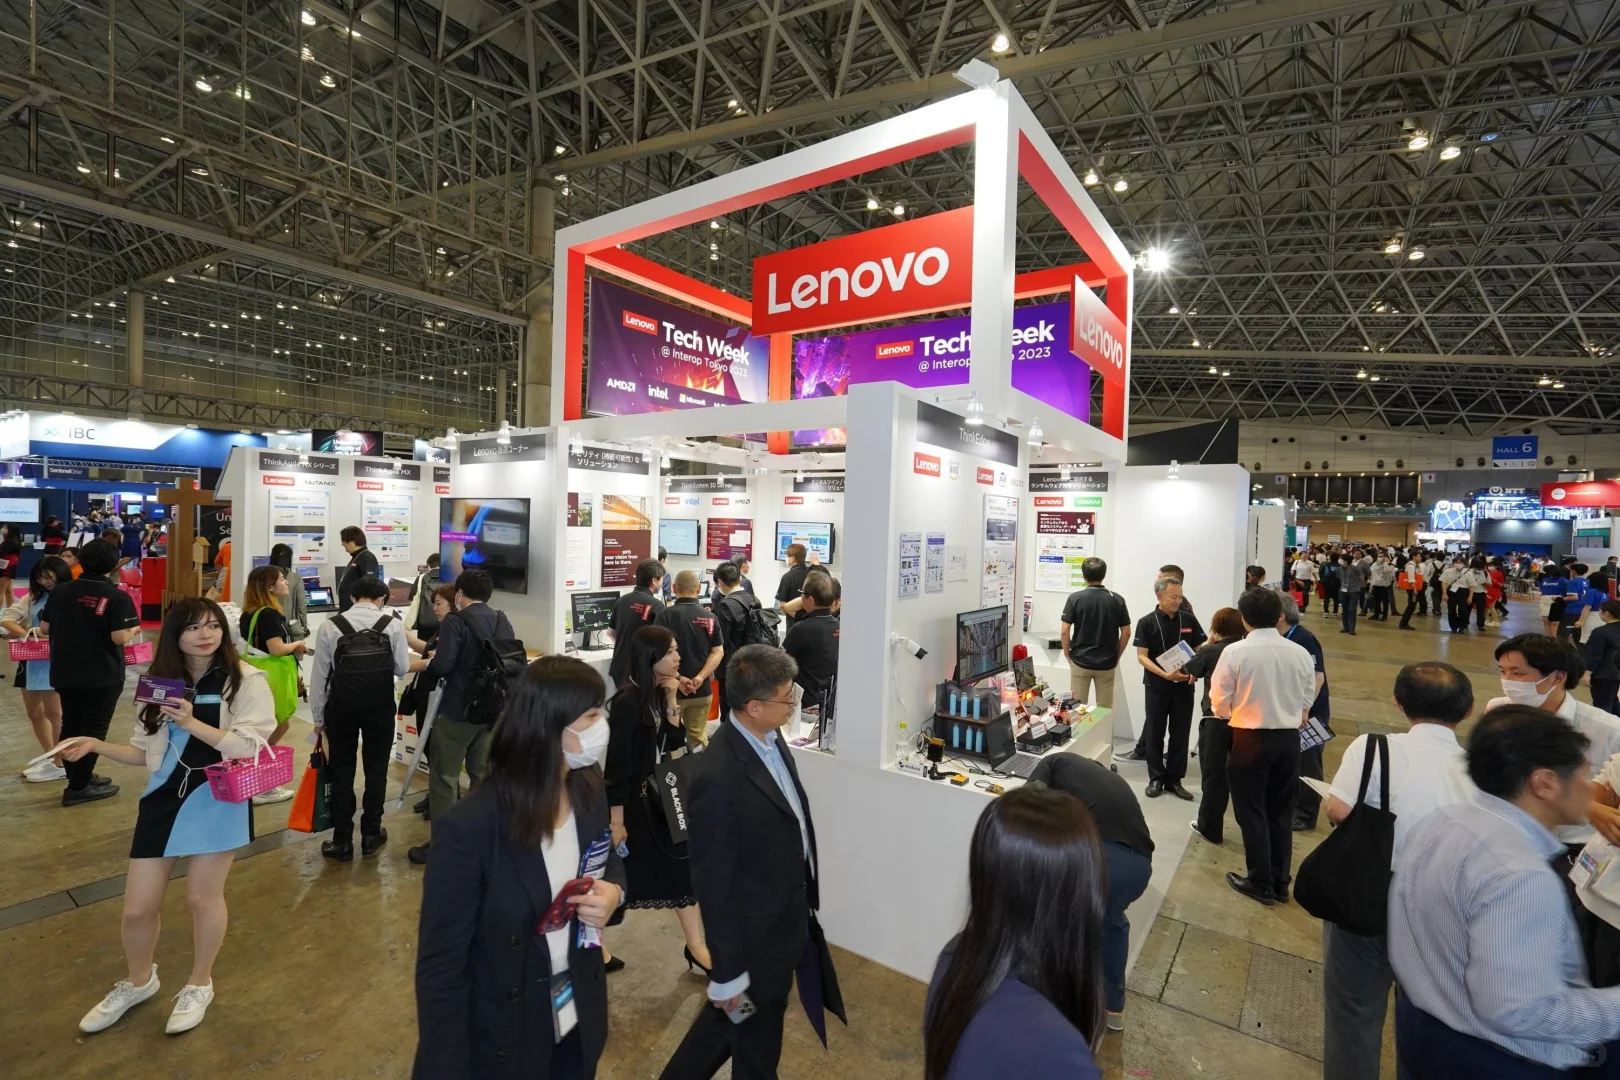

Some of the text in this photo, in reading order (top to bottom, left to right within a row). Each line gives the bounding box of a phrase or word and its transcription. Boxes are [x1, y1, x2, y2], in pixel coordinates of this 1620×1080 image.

[768, 247, 949, 315] Lenovo
[625, 314, 655, 331] Lenovo
[1012, 320, 1055, 347] eek
[1079, 299, 1123, 369] Lenovo
[662, 321, 750, 366] Tech Week
[878, 343, 911, 355] Lenovo
[661, 346, 748, 378] @ Interop Tokyo 2023
[918, 360, 929, 373] @
[933, 357, 971, 372] Interop
[1018, 346, 1051, 361] 2023
[606, 378, 629, 392] AMD
[648, 384, 669, 400] intel
[68, 427, 96, 440] IBC
[958, 426, 990, 449] ThinkEdge
[1522, 442, 1533, 453] 6
[49, 467, 83, 475] SentinelOne
[263, 458, 300, 468] ThinkAgile
[313, 462, 336, 470] シリーズ
[365, 466, 399, 475] ThinkAgile
[577, 458, 618, 469] ソリューション
[916, 457, 939, 472] Lenovo
[265, 476, 293, 484] Lenovo
[978, 471, 993, 482] Lenovo
[670, 787, 687, 831] BLACK BOX
